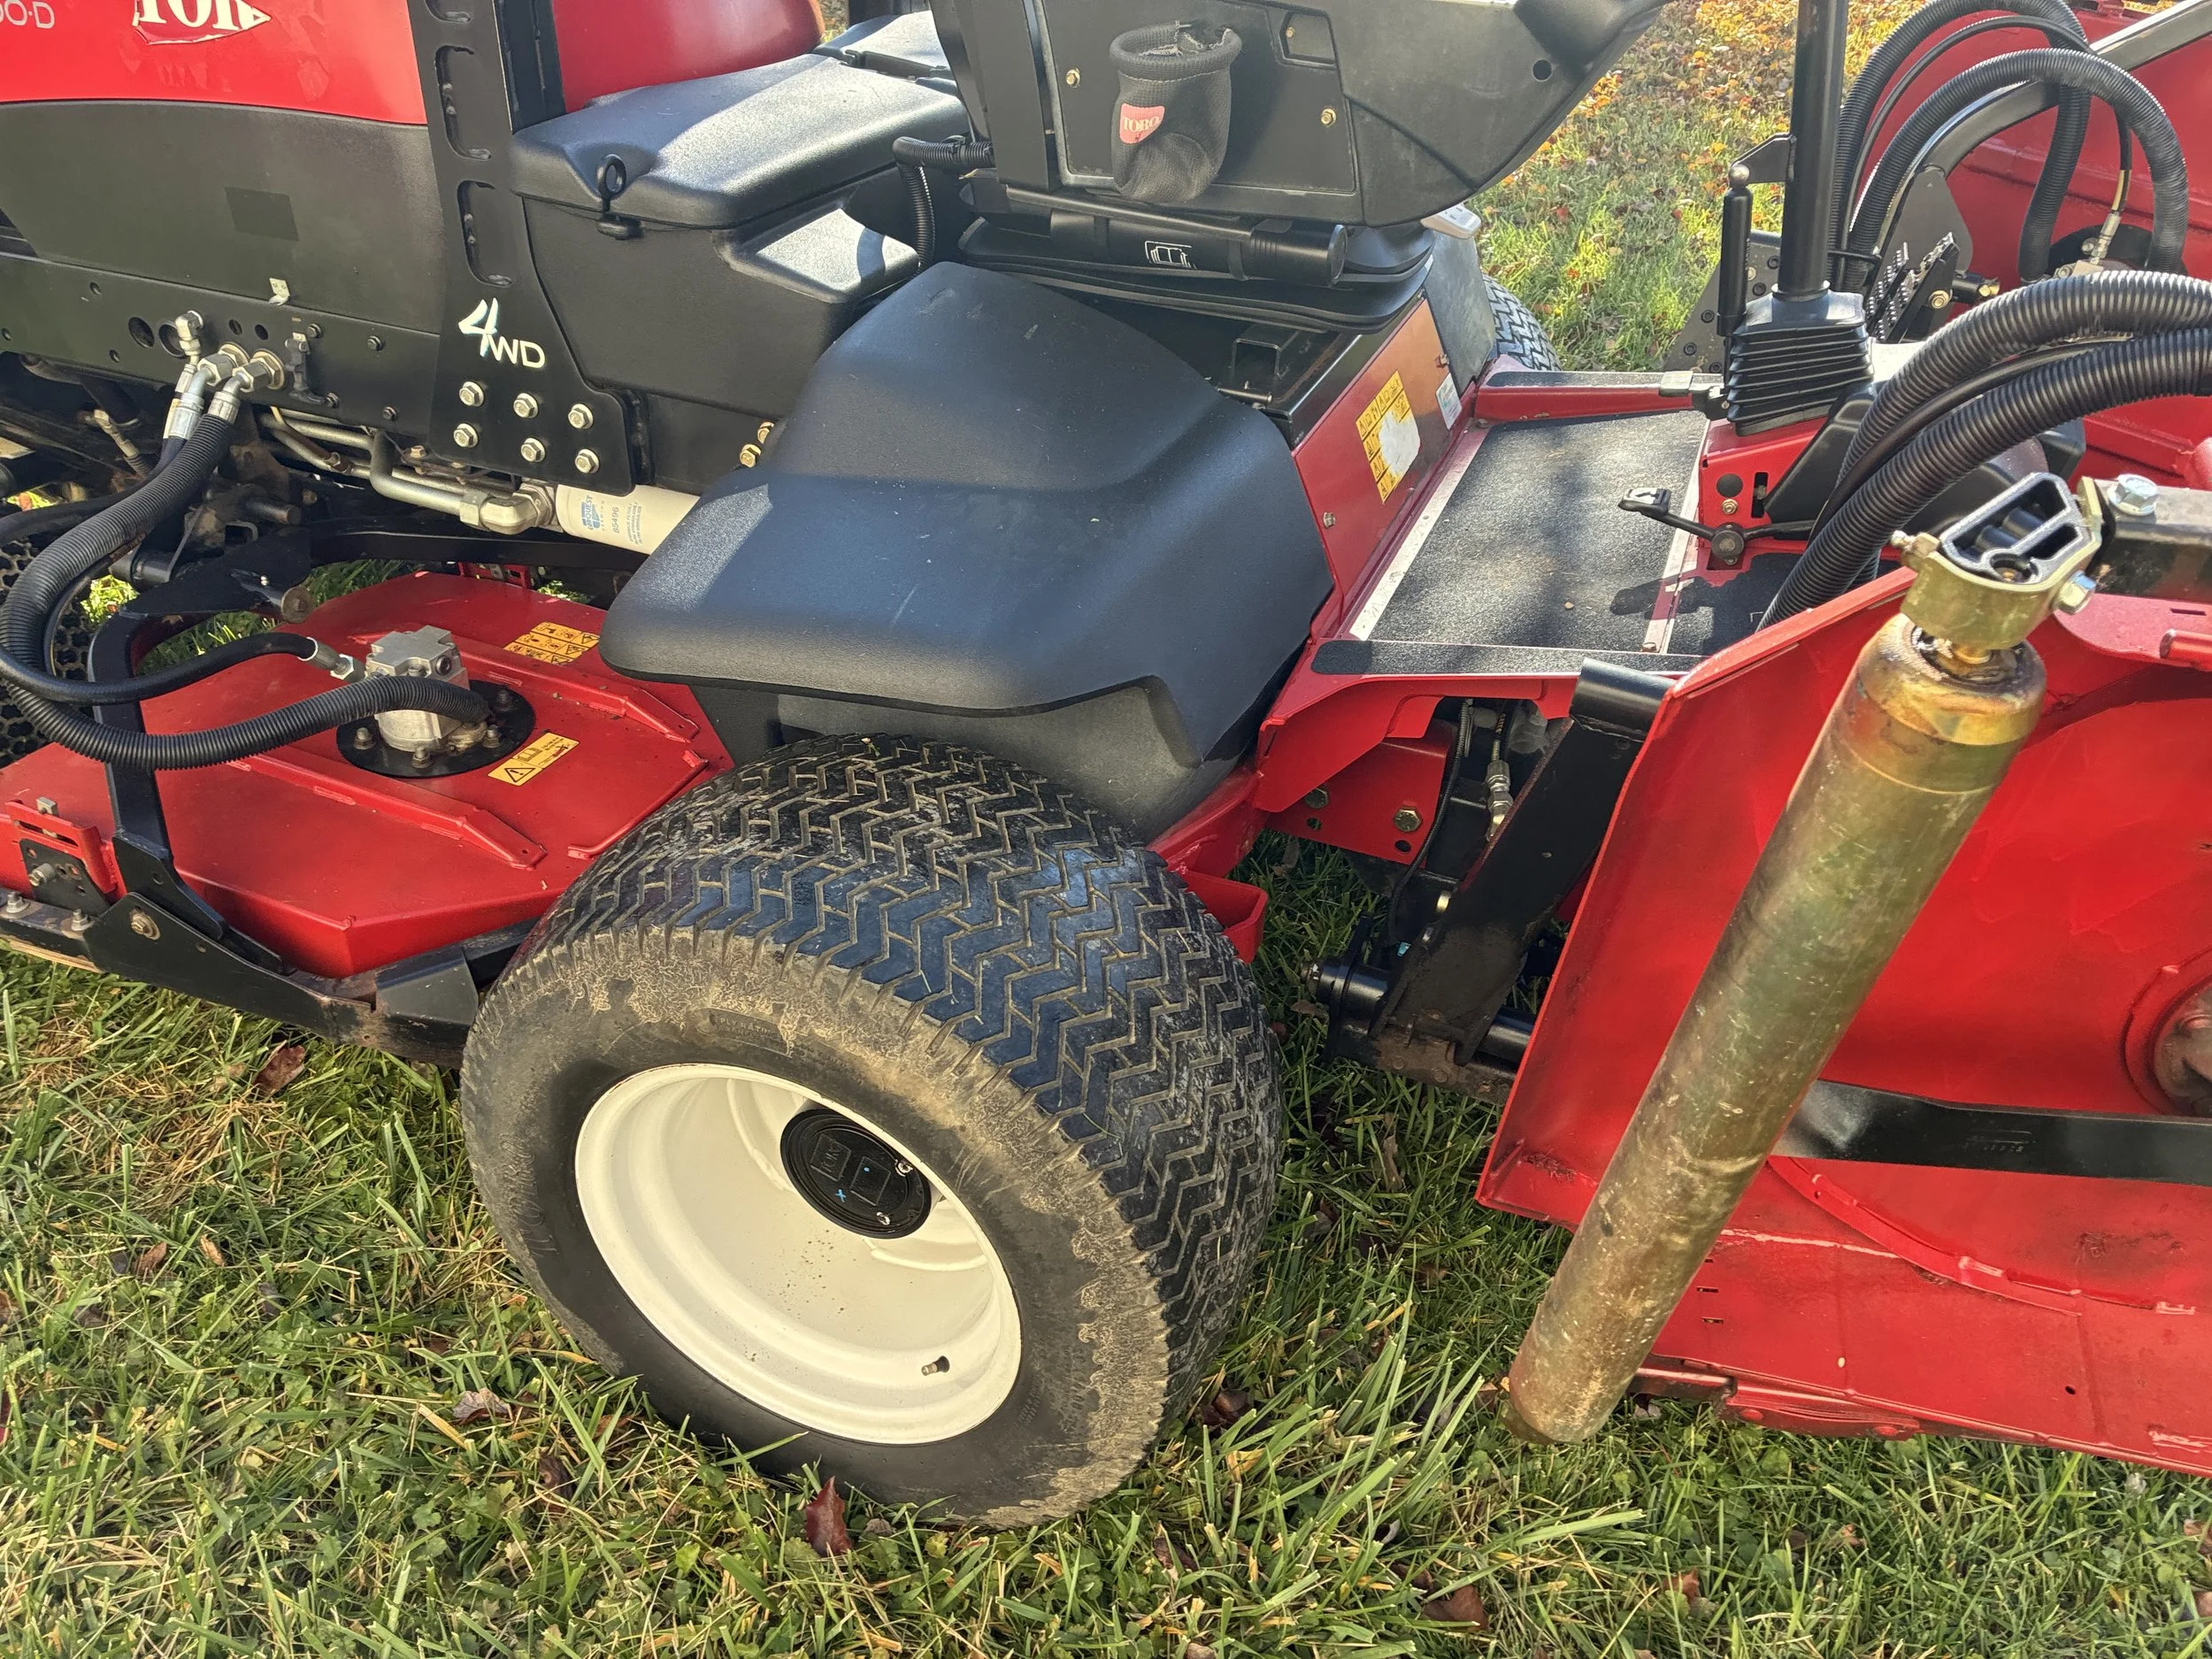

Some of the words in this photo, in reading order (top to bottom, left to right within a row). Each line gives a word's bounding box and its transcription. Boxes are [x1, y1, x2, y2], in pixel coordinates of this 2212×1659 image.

[1123, 116, 1160, 133] TORO
[458, 297, 546, 368] 4WD
[720, 1018, 736, 1026] PLY
